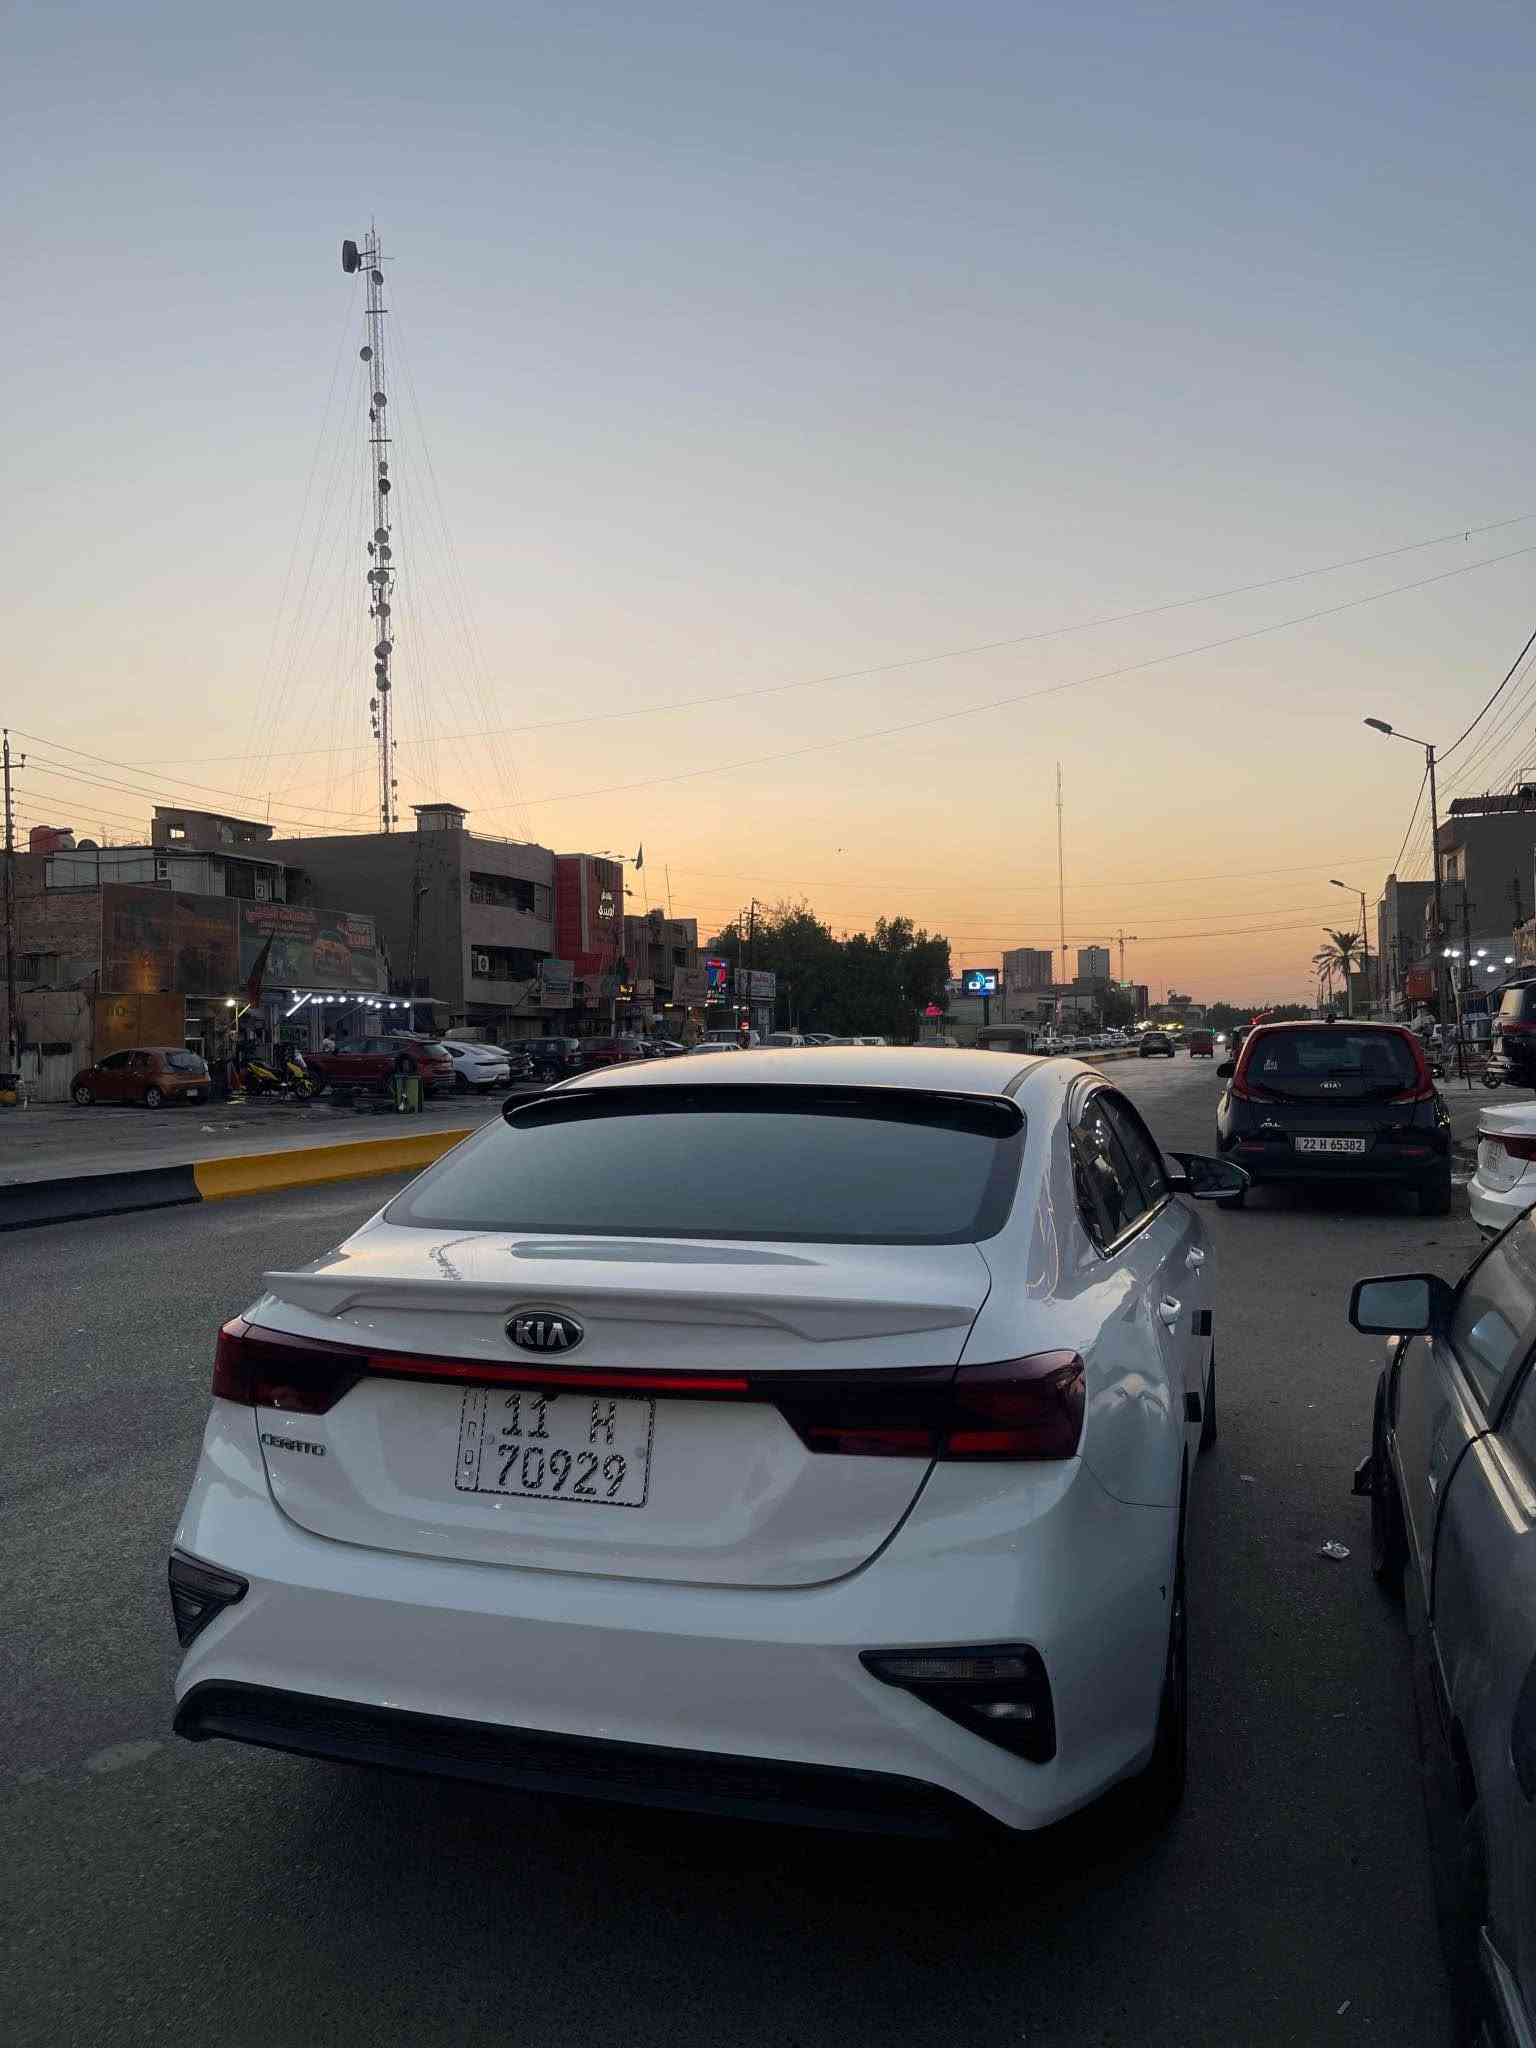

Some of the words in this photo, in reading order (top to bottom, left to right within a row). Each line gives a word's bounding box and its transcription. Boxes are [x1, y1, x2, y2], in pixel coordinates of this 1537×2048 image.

[1303, 1138, 1316, 1149] 22
[1319, 1138, 1328, 1149] H
[1330, 1139, 1362, 1151] 65382
[515, 1319, 569, 1346] KIA
[502, 1393, 550, 1439] 11
[590, 1398, 616, 1445] H
[497, 1443, 626, 1497] 70929
